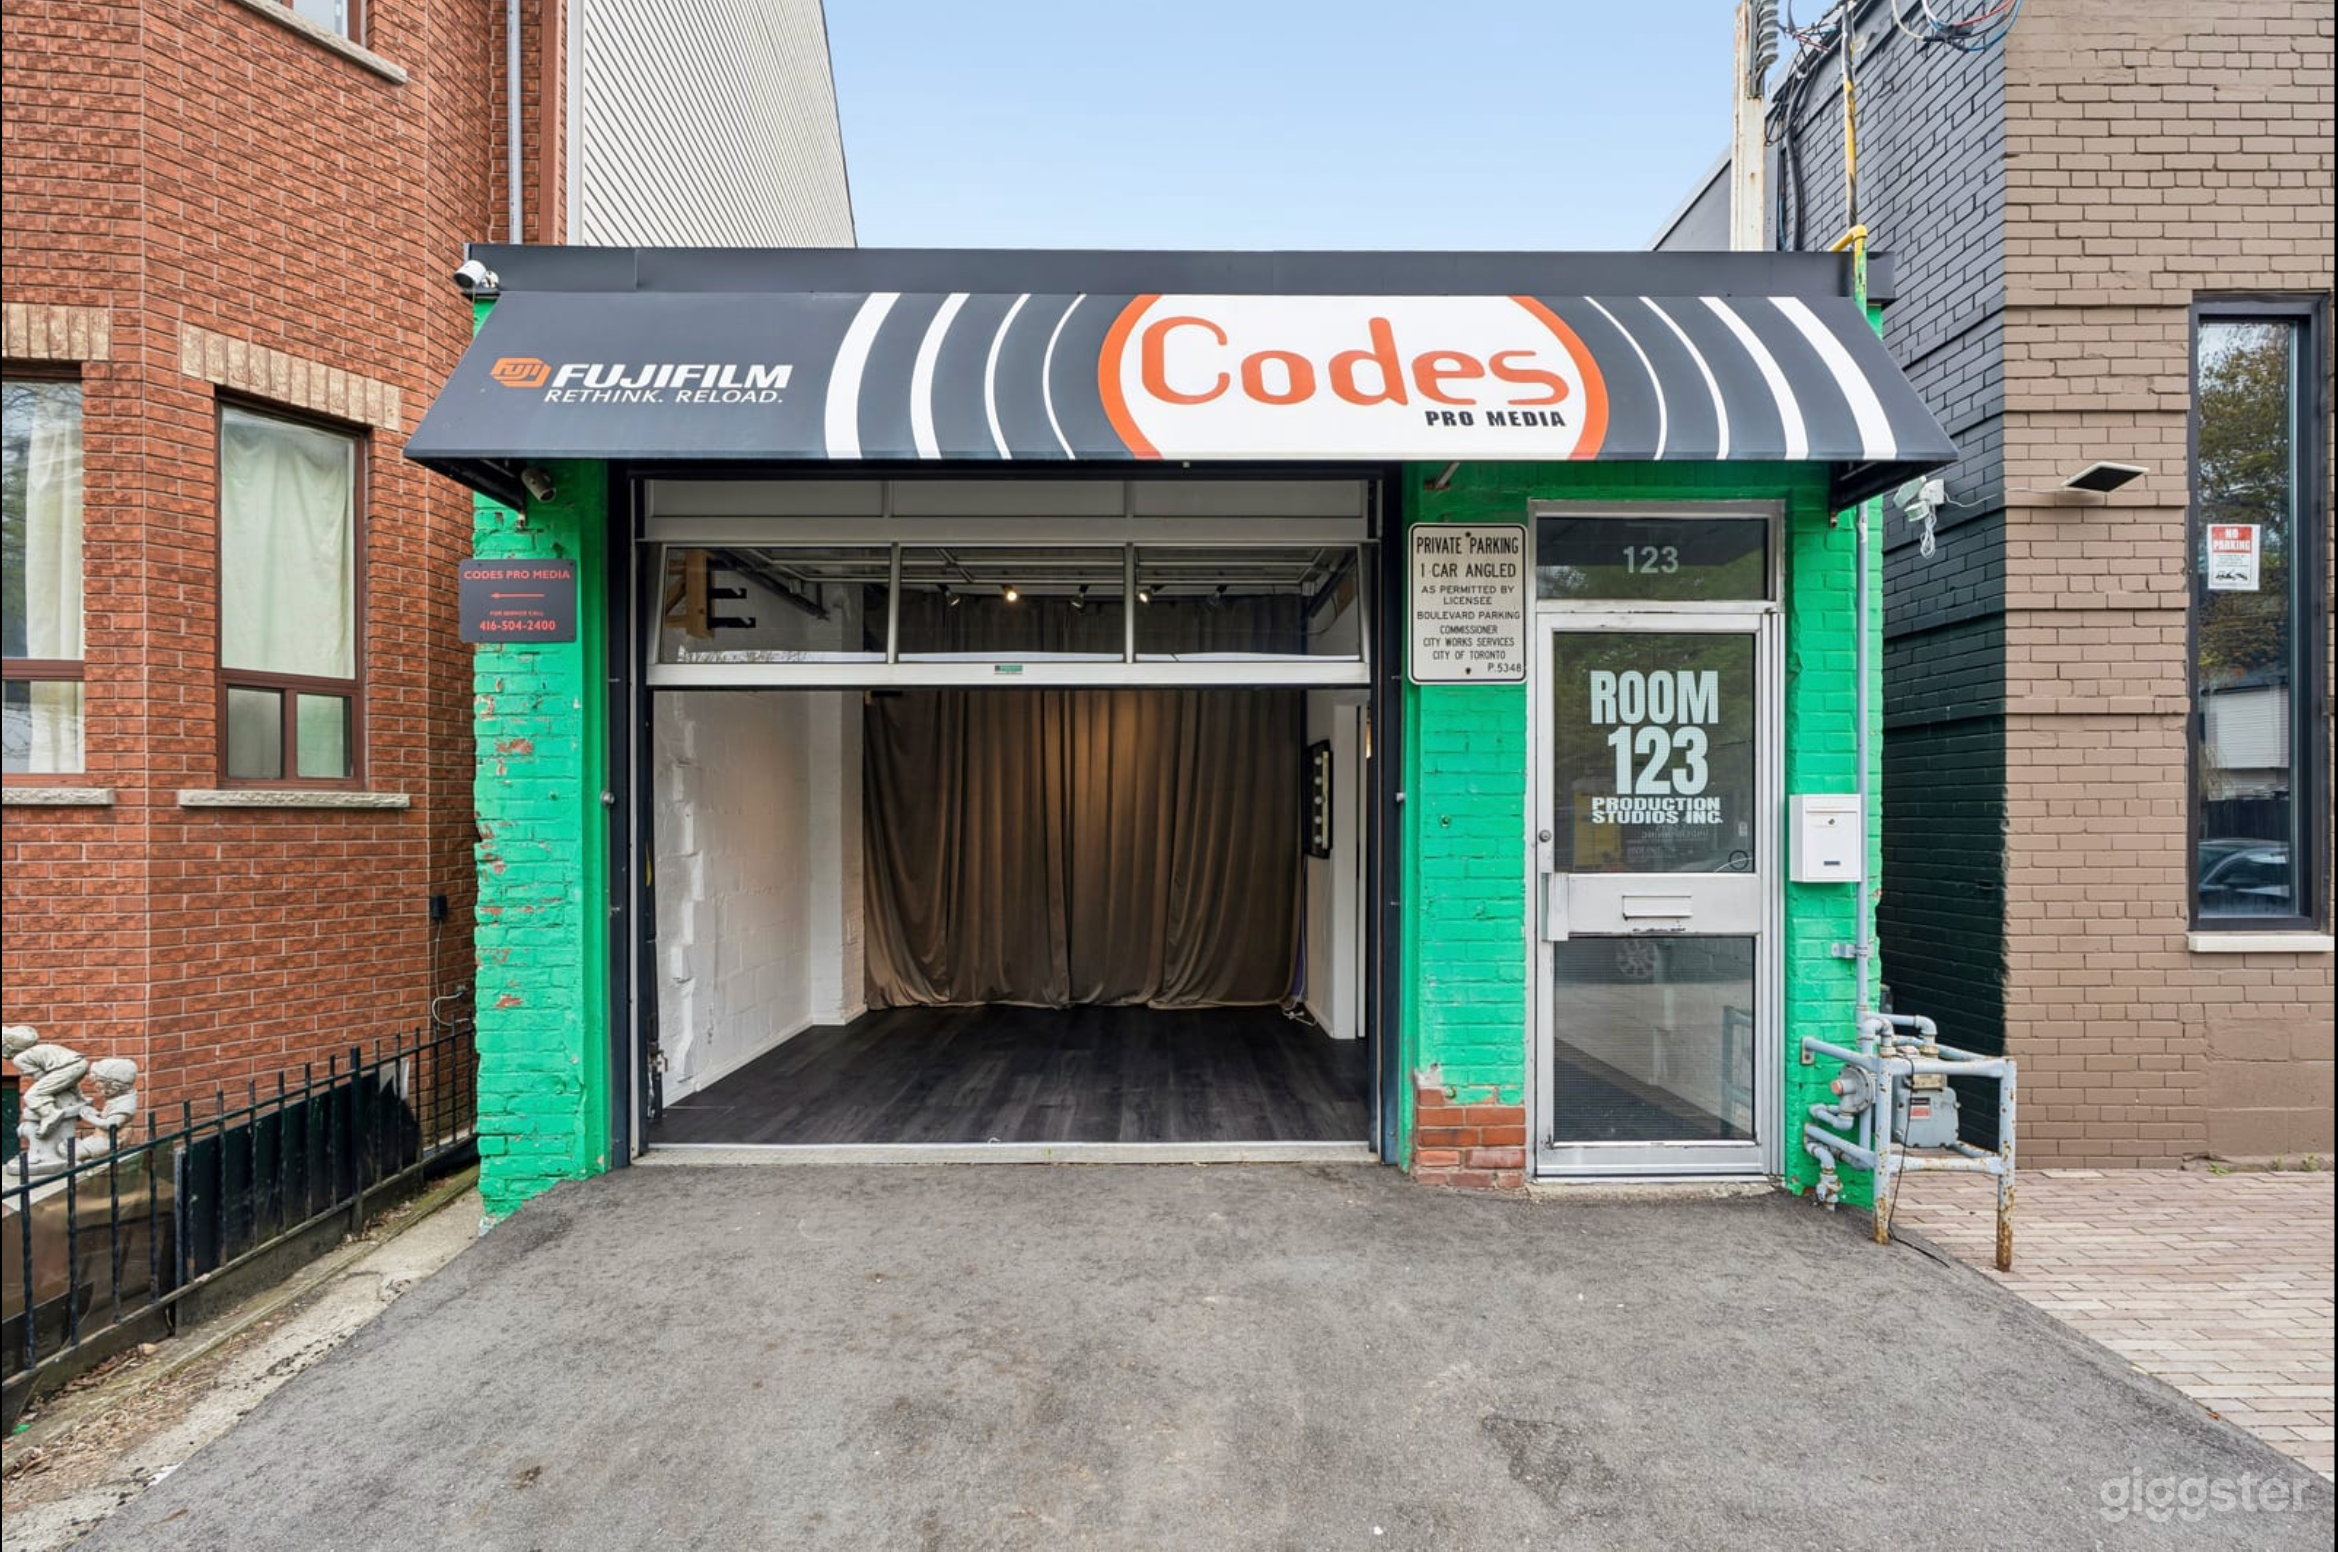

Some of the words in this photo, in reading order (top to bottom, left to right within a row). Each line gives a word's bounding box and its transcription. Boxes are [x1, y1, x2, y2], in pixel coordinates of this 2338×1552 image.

[1141, 315, 1570, 406] Codes
[551, 363, 794, 389] FUJIFILM
[544, 389, 664, 403] RETHINK.
[675, 389, 783, 403] RELOAD.
[1424, 410, 1474, 427] PRO
[1486, 410, 1567, 427] MEDIA
[2225, 528, 2239, 540] NO
[1416, 536, 1462, 554] PRIVATE
[1469, 536, 1519, 554] PARKING
[2212, 540, 2251, 551] PARKING
[1622, 546, 1679, 574] 123
[464, 570, 503, 579] CODES
[505, 570, 530, 579] PRO
[533, 569, 571, 579] MEDIA
[1421, 563, 1425, 578] 1
[1431, 562, 1458, 578] CAR
[1465, 562, 1517, 578] ANGLED
[1421, 585, 1436, 594] AS
[1439, 585, 1497, 594] PERMITTED
[1500, 585, 1515, 594] BY
[1443, 596, 1492, 605] LICENSEE
[1417, 611, 1475, 620] BOULEVARD
[1478, 611, 1520, 620] PARKING
[479, 620, 557, 631] 416-504-2400
[1440, 625, 1498, 634] COMMISSIONER
[1423, 637, 1441, 647] CITY
[1445, 637, 1473, 647] WORKS
[1477, 637, 1515, 647] SERVICES
[1432, 650, 1450, 660] CITY
[1455, 650, 1465, 660] OF
[1469, 650, 1506, 660] TORONTO
[1487, 663, 1522, 673] P.5348
[1590, 670, 1719, 724] ROOM
[1607, 726, 1709, 795] 123
[1591, 797, 1721, 810] PRODUCTION
[1591, 810, 1679, 824] STUDIOS
[1685, 810, 1724, 824] INC.
